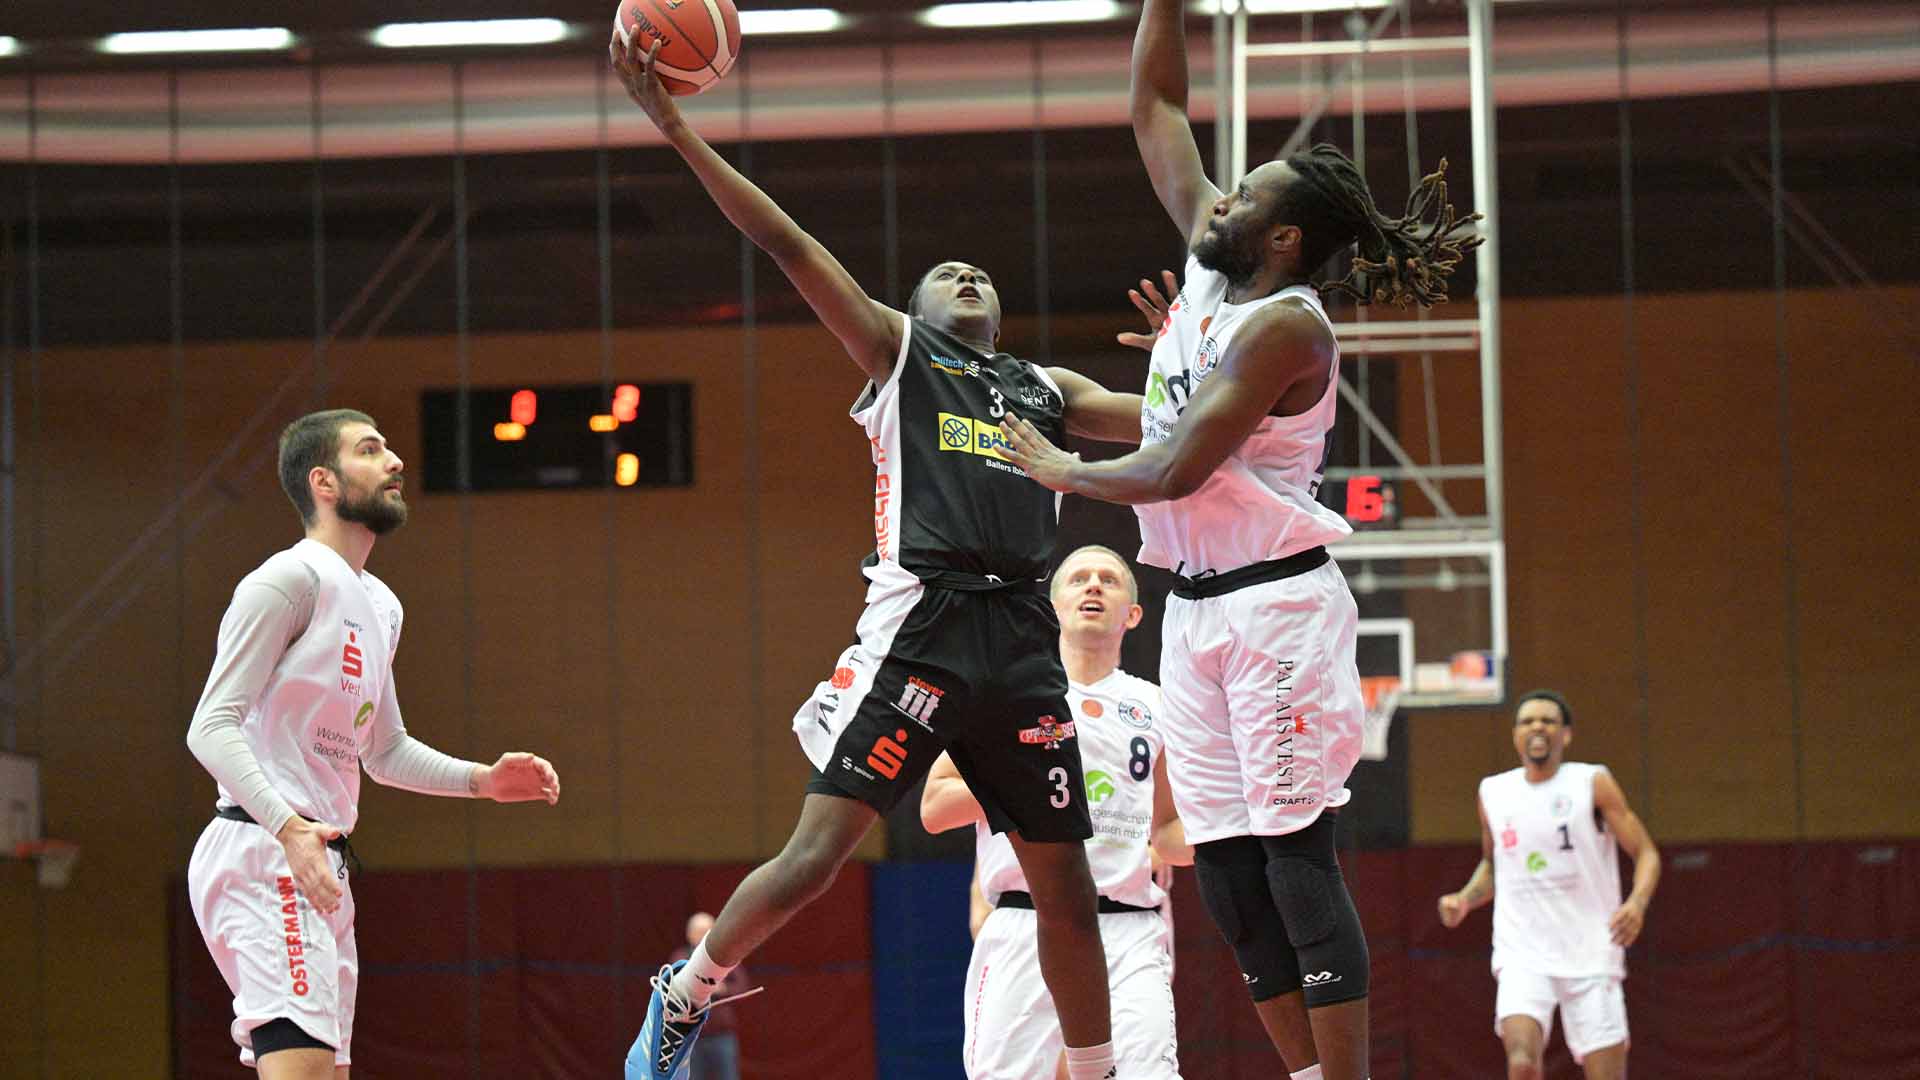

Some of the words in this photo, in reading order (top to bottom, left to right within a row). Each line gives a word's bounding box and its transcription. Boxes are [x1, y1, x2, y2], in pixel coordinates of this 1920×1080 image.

[989, 387, 1005, 418] 3
[985, 459, 1011, 473] Ballers
[340, 677, 361, 697] Vest
[897, 683, 940, 725] fit
[908, 675, 945, 698] clever
[1276, 660, 1295, 735] PALAIS
[1129, 736, 1151, 782] 8
[1277, 737, 1294, 792] VEST
[1048, 766, 1071, 809] 3
[1273, 797, 1306, 806] CRAFT
[1557, 823, 1574, 851] 1
[277, 876, 309, 997] OSTERMANN
